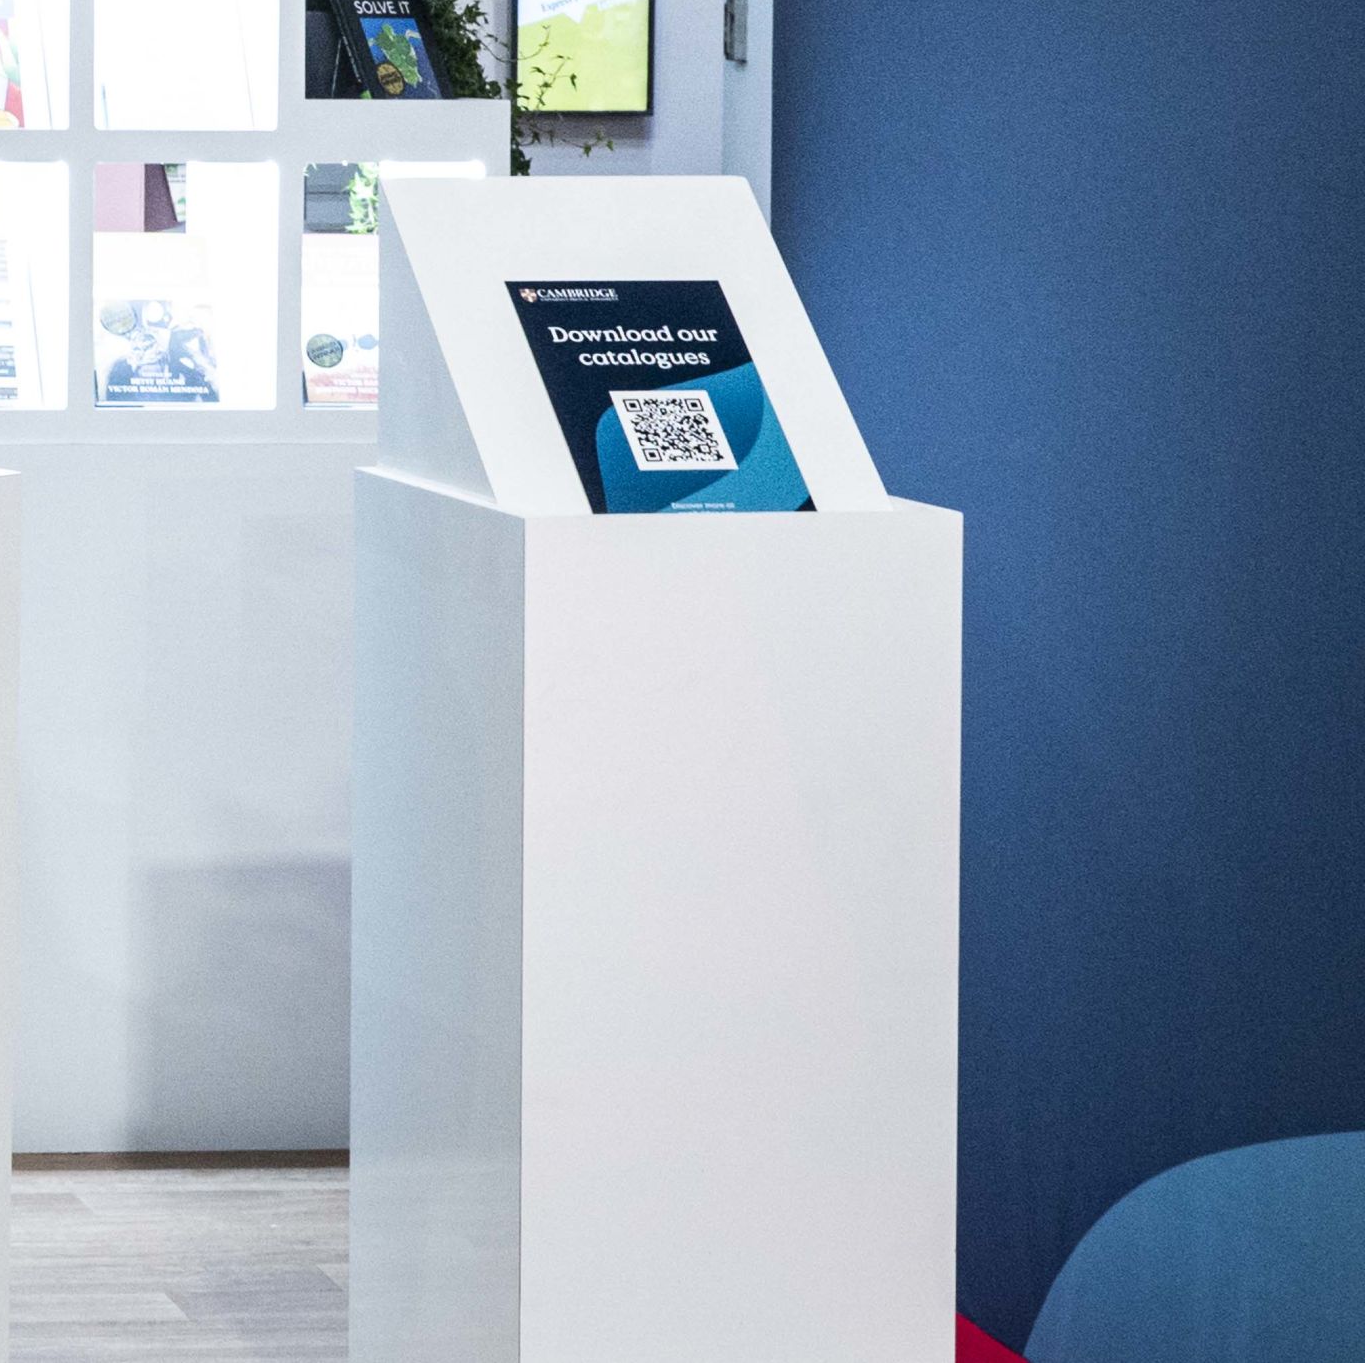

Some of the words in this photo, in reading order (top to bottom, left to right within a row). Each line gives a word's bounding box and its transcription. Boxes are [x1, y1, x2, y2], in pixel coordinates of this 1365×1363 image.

[353, 0, 397, 15] SOLVE
[399, 1, 411, 15] IT
[536, 288, 617, 298] CAMBRIDGE
[547, 325, 675, 343] Download
[677, 328, 718, 342] our
[578, 348, 711, 369] catalogues
